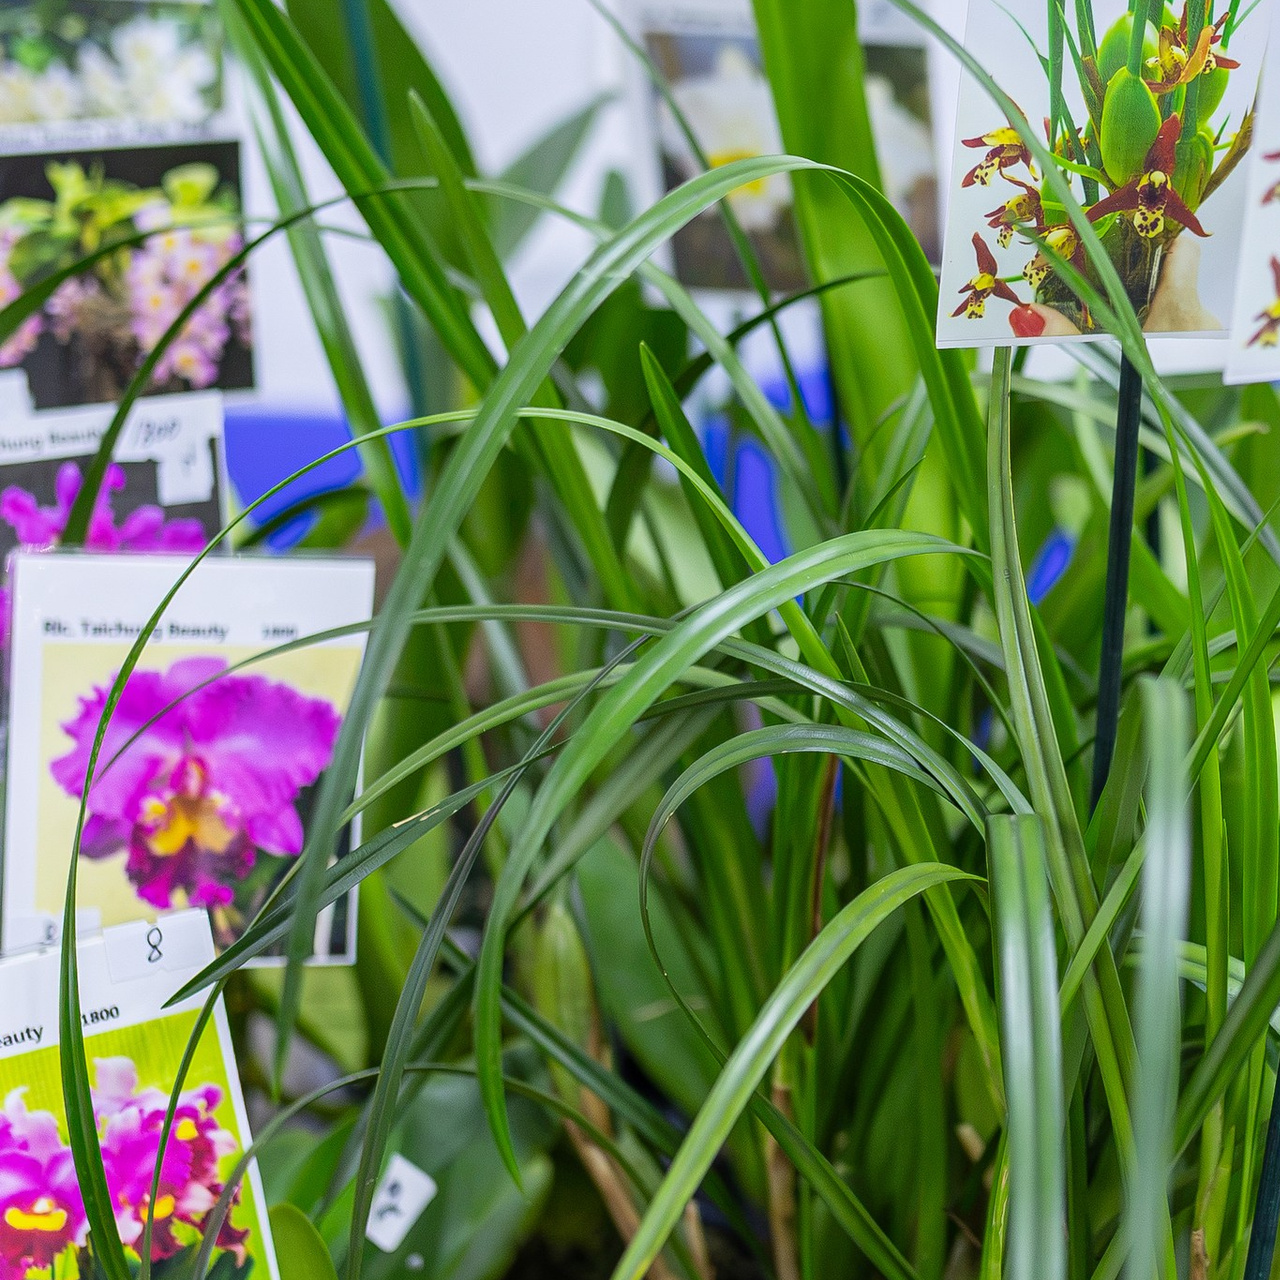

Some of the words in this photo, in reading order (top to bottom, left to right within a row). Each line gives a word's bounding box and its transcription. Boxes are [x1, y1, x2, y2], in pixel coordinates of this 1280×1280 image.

[79, 619, 163, 640] Taichug
[146, 926, 163, 963] 8
[81, 1005, 120, 1027] 1800
